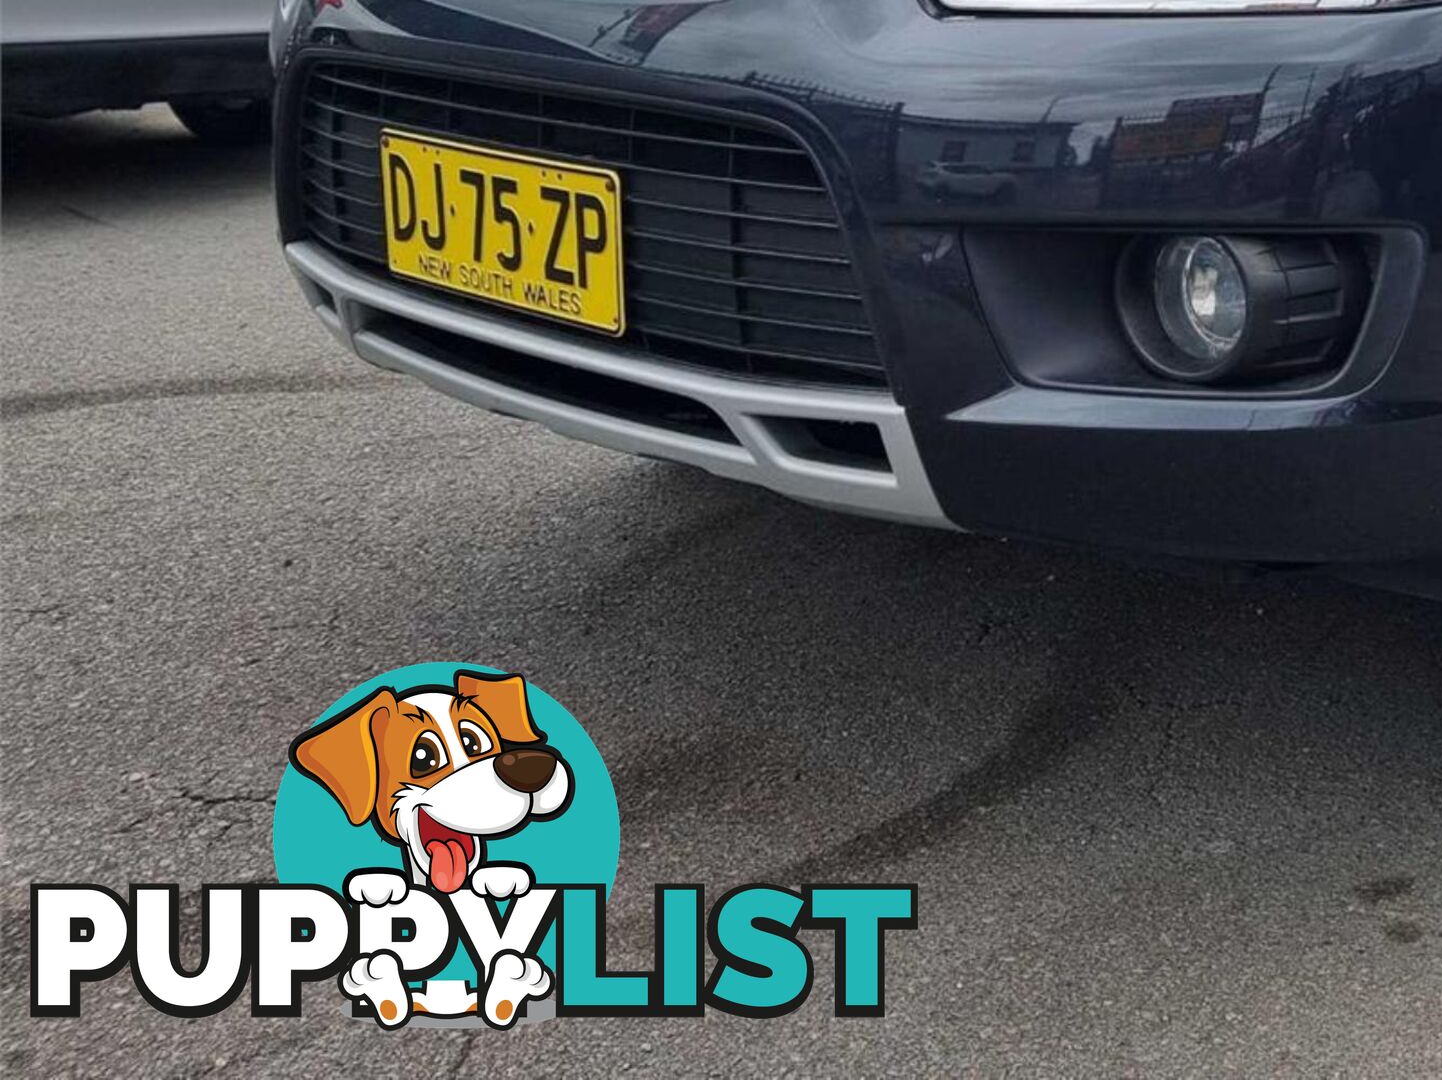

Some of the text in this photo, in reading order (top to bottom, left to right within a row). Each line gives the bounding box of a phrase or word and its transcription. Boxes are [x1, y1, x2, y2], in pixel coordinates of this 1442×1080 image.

[418, 255, 582, 314] NEW SOUTH WALES
